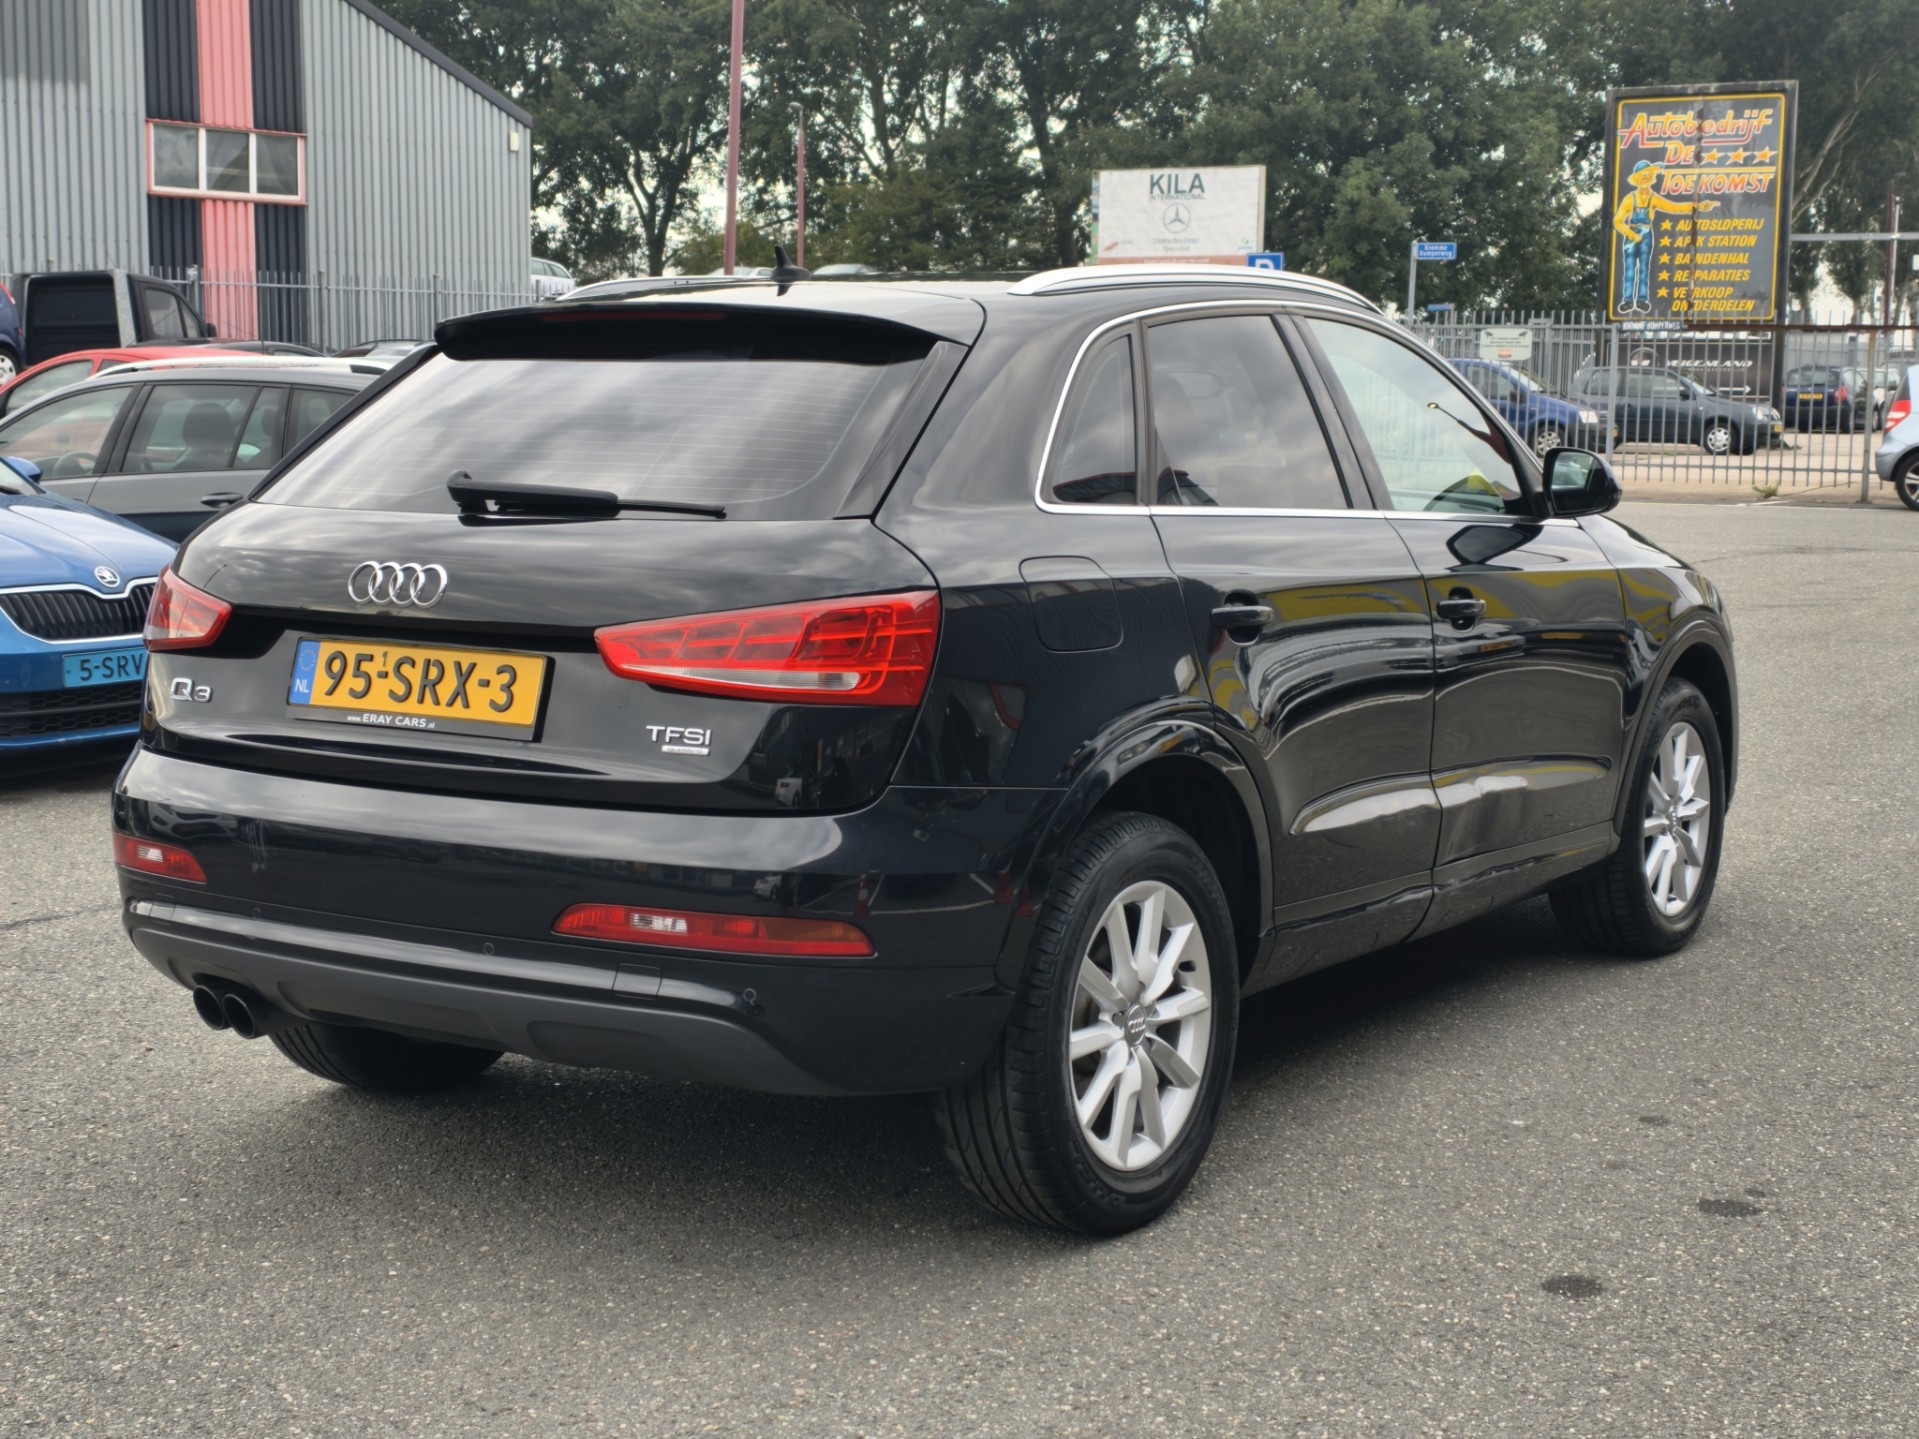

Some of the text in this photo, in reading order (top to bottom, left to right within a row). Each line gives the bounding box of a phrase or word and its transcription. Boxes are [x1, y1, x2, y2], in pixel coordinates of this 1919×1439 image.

[1150, 173, 1205, 194] KILA
[1151, 193, 1206, 201] INTERNATIONAL
[1707, 235, 1757, 247] STATION
[170, 677, 212, 702] Q3
[295, 678, 309, 694] NL
[324, 650, 517, 713] 95-SRX-3
[645, 725, 711, 745] TFSI
